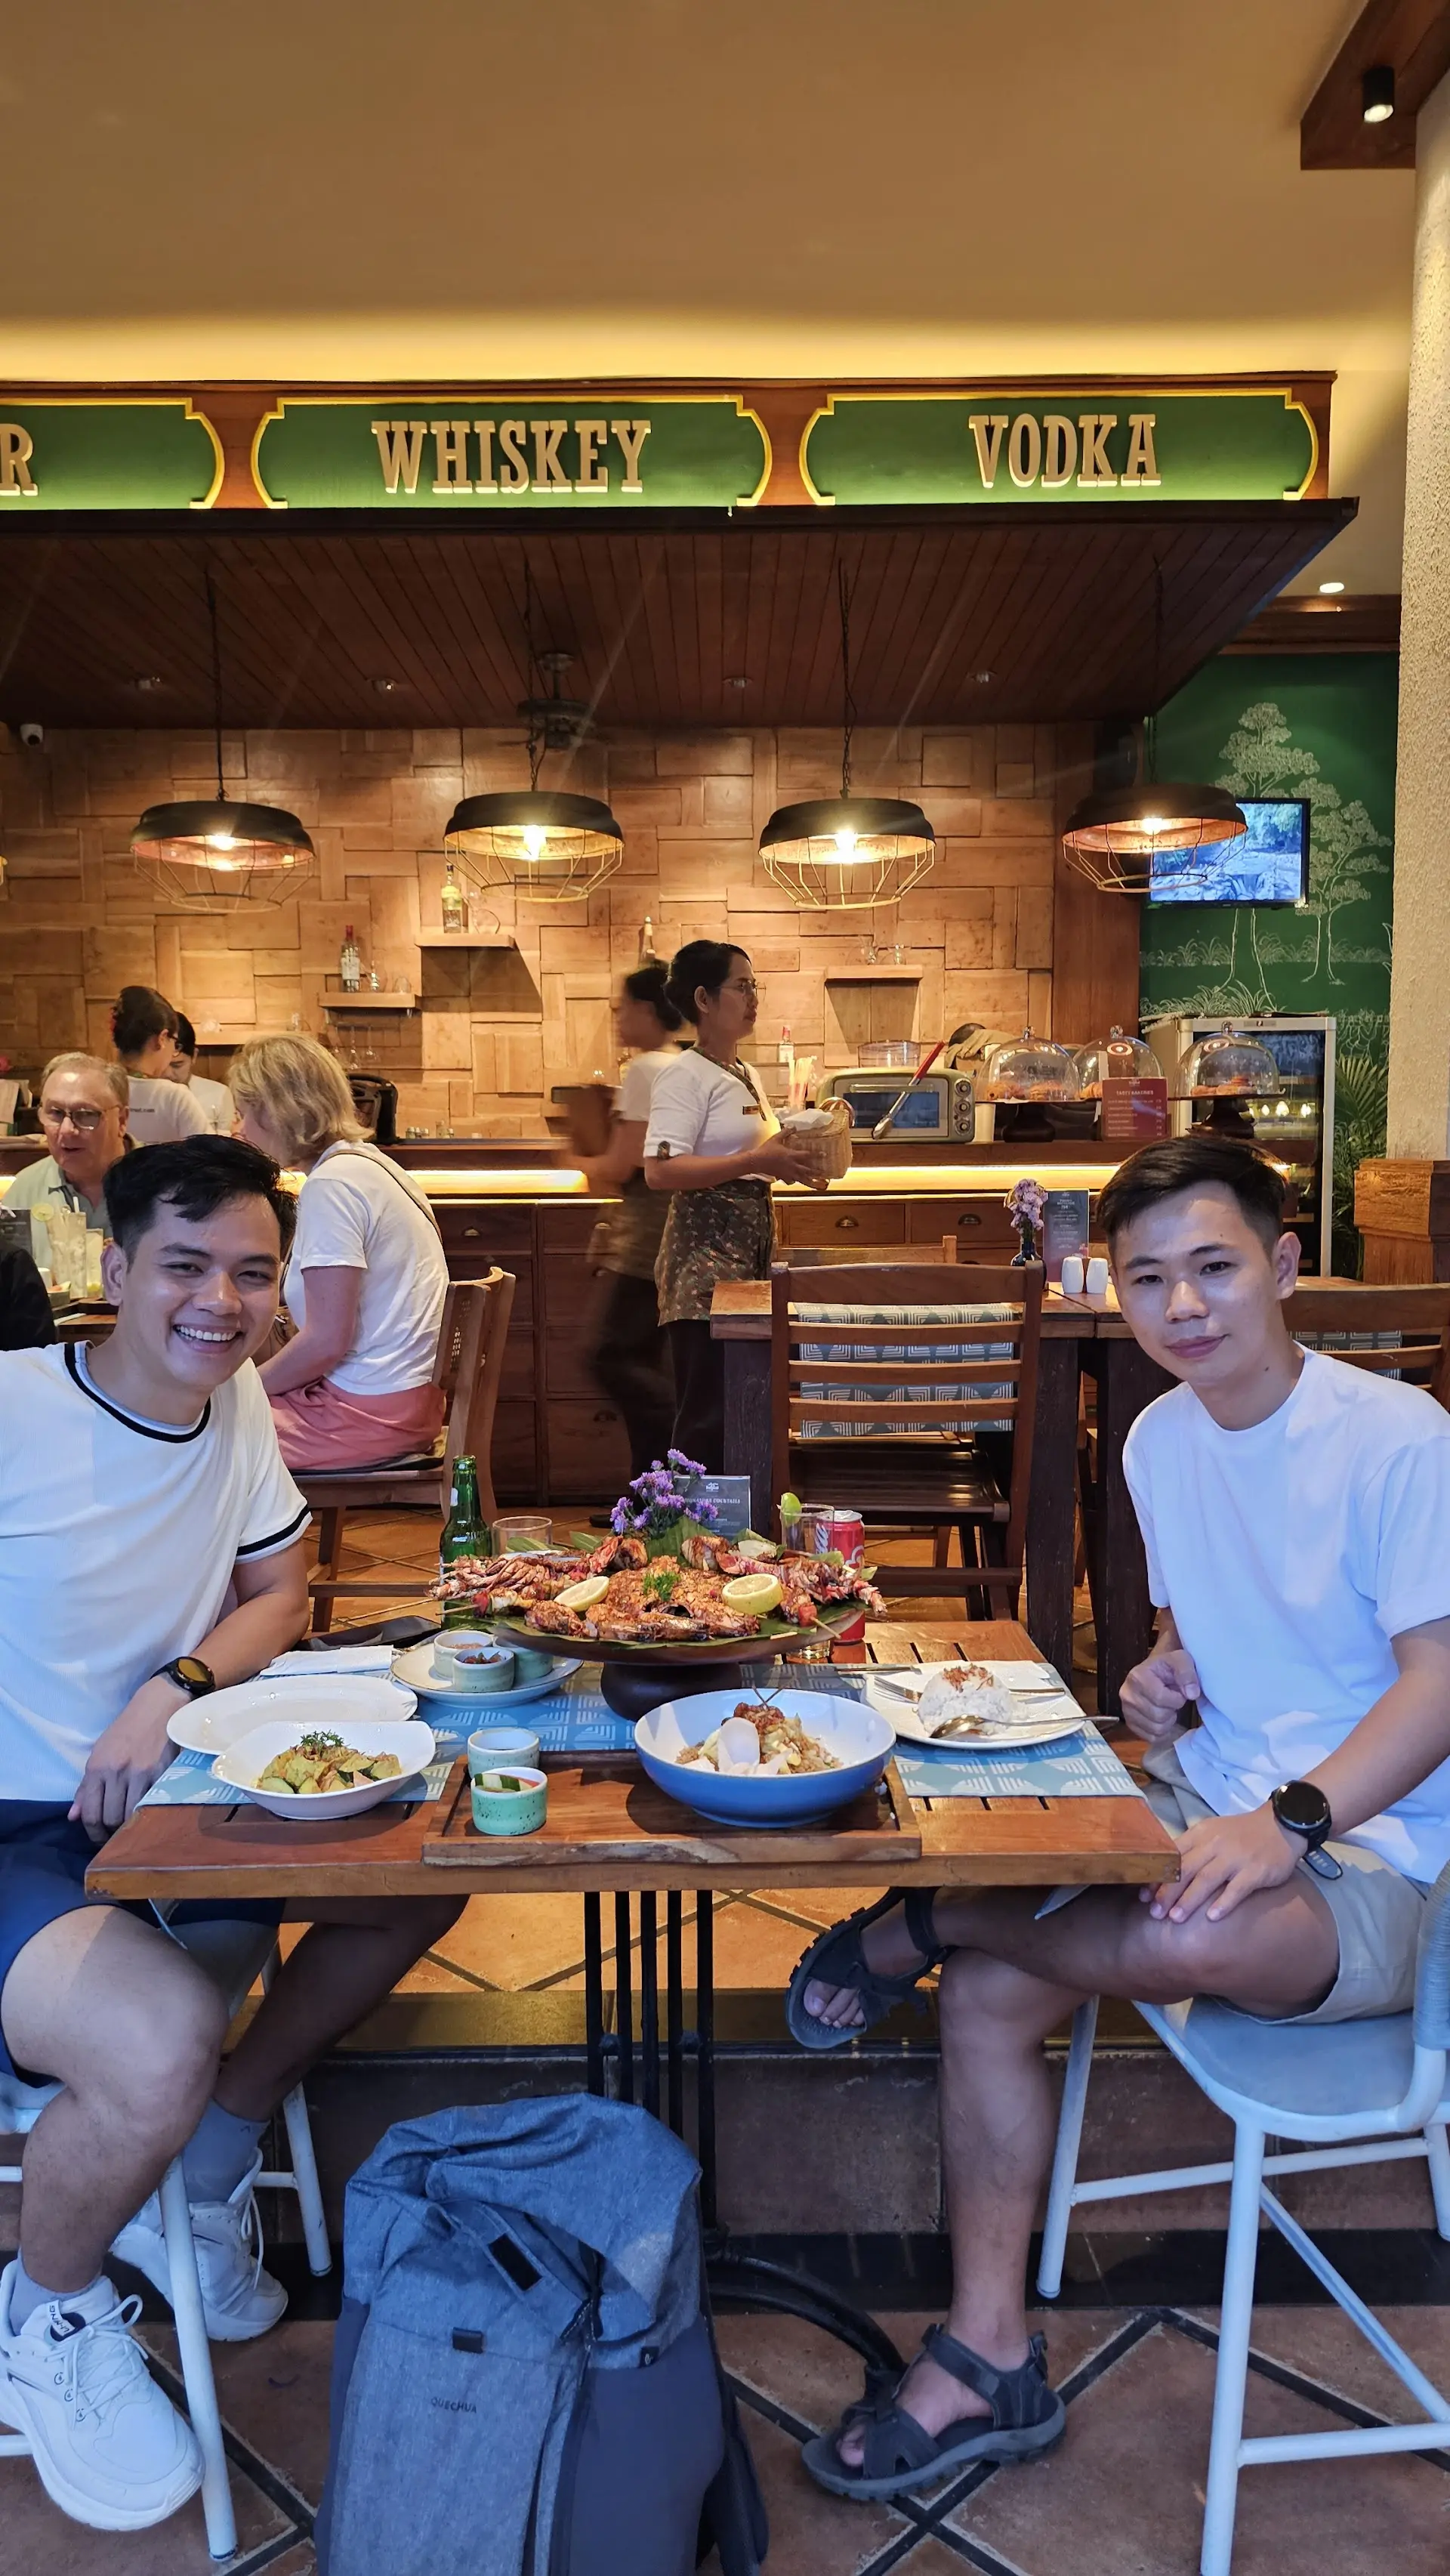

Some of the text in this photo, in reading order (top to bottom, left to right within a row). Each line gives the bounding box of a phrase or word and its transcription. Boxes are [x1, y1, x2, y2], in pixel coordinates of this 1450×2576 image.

[0, 423, 38, 496] R
[371, 420, 652, 493] WHISKEY
[968, 413, 1162, 488] VODKA
[430, 2396, 477, 2414] QUECHUA
